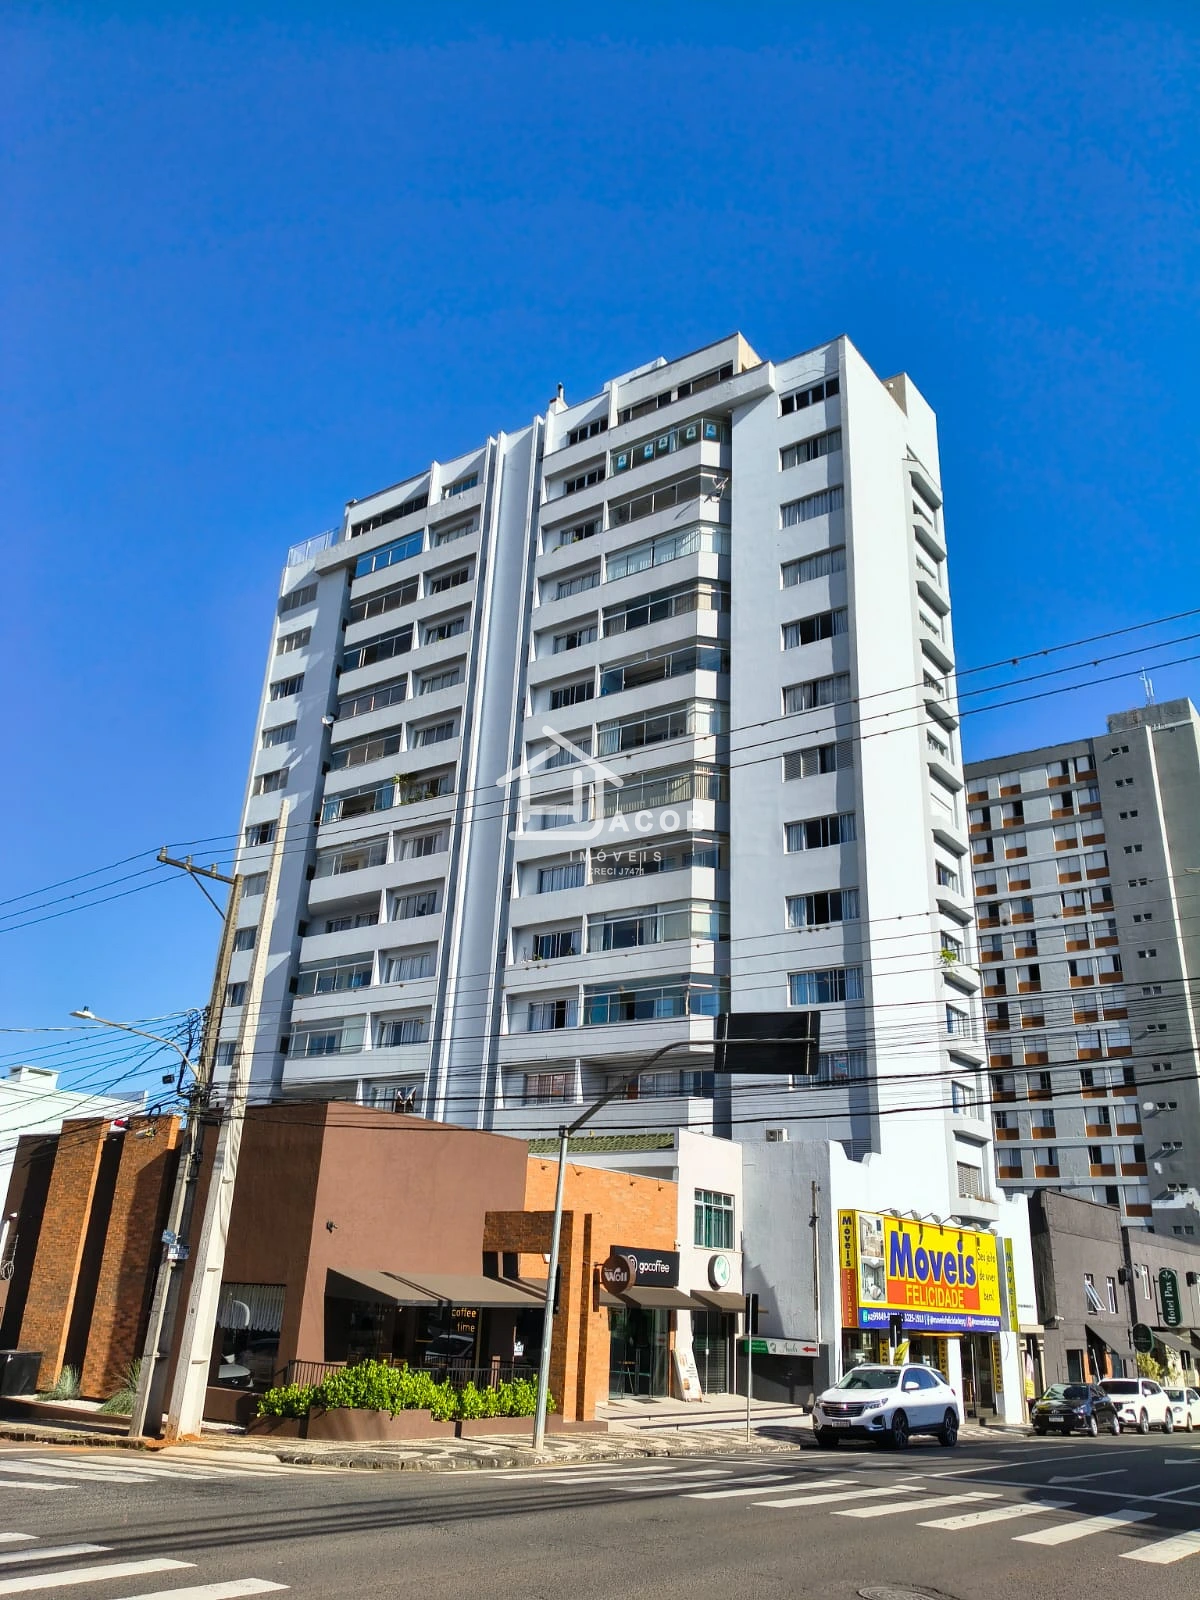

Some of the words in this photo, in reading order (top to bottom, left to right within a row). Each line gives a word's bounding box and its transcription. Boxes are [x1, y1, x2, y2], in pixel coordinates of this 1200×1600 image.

[638, 1259, 671, 1274] gocoffee
[889, 1230, 978, 1287] Móveis
[905, 1284, 965, 1309] FELICIDADE
[451, 1307, 477, 1318] coffee
[1165, 1299, 1177, 1324] Hotel
[457, 1321, 475, 1333] time
